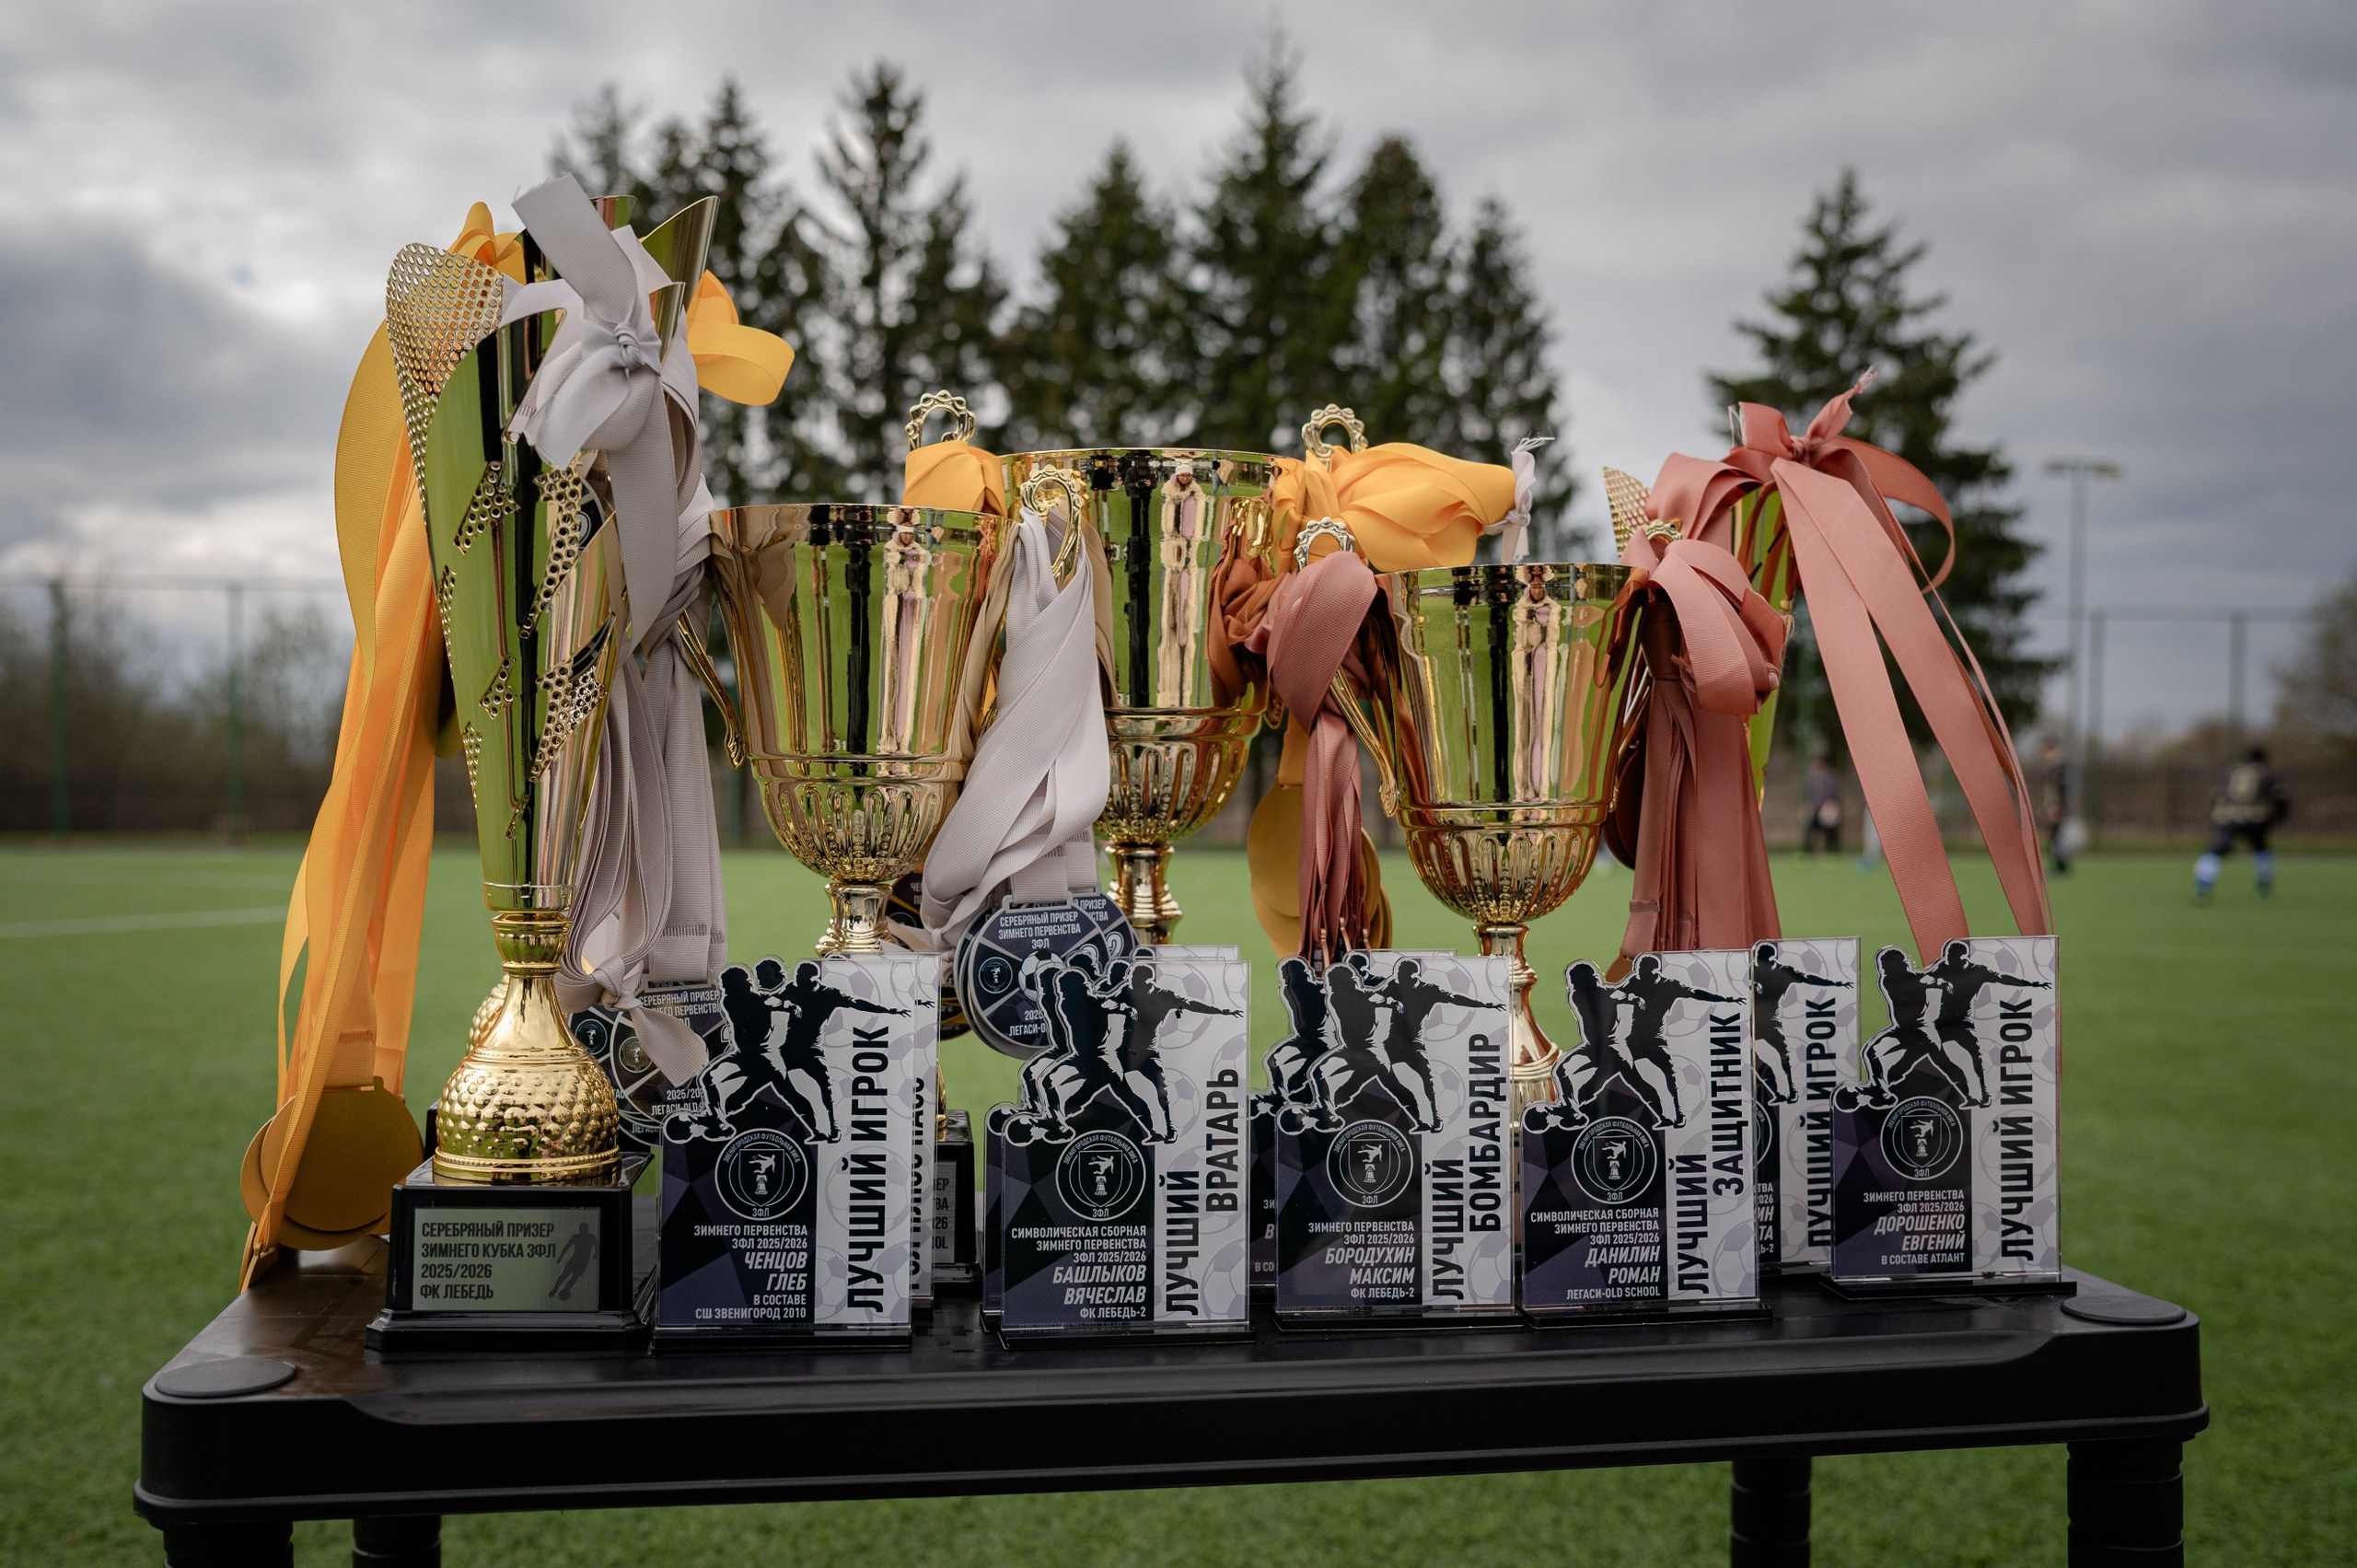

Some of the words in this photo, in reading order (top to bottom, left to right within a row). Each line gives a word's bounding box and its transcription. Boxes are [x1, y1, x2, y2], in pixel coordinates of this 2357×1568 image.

[1000, 912, 1050, 927] СЕРЕБРЯНЫЙ
[1050, 912, 1078, 923] ПРИЗЕР
[998, 926, 1033, 940] ЗИМНЕГО
[1035, 923, 1081, 937] ПЕРВЕНСТВА
[1031, 938, 1050, 949] ЗФЛ
[675, 1003, 720, 1016] ПЕРВЕНСТВ
[1805, 997, 1837, 1100] ИГРОК
[2000, 998, 2033, 1105] ИГРОК
[851, 1027, 888, 1141] ИГРОК
[1710, 1013, 1748, 1196] ЗАЩИТНИК
[1206, 1068, 1238, 1212] ВРАТАРЬ
[1469, 1033, 1506, 1232] БОМБАРДИР
[1800, 1110, 1831, 1248] ЛУЧШИЙ
[1914, 1168, 1930, 1178] ЗФЛ
[1607, 1191, 1623, 1201] ЗФЛ
[1864, 1191, 1905, 1202] ЗИМНЕГО
[1907, 1190, 1964, 1201] ПЕРВЕНСТВА
[1992, 1116, 2033, 1260] ЛУЧШИЙ
[1362, 1195, 1378, 1204] ЗФЛ
[752, 1208, 770, 1217] ЗФЛ
[1092, 1209, 1109, 1218] ЗФЛ
[1530, 1210, 1612, 1222] СИМВОЛИЧЕСКАЯ
[1615, 1208, 1659, 1220] СБОРНАЯ
[1898, 1203, 1917, 1214] ЗФЛ
[1920, 1202, 1964, 1213] 2025/2026
[422, 1221, 504, 1237] СЕРЕБРЯНЫЙ
[506, 1223, 554, 1237] ПРИЗЕР
[694, 1225, 740, 1236] ЗИМНЕГО
[743, 1225, 807, 1236] ПЕРВЕНСТВА
[1011, 1227, 1098, 1238] СИМВОЛИЧЕСКАЯ
[1100, 1225, 1146, 1237] СБОРНАЯ
[1308, 1223, 1352, 1233] ЗИМНЕГО
[1353, 1221, 1414, 1232] ПЕРВЕНСТВА
[1425, 1159, 1464, 1300] ЛУЧШИЙ
[1554, 1223, 1597, 1234] ЗИМНЕГО
[1600, 1220, 1659, 1232] ПЕРВЕНСТВА
[1668, 1154, 1709, 1294] ЛУЧШИЙ
[1874, 1214, 1966, 1236] ДОРОШЕНКО
[842, 1154, 887, 1313] ЛУЧШИЙ
[1343, 1235, 1364, 1245] ЗФЛ
[1367, 1234, 1414, 1244] 2025/2026
[1590, 1235, 1610, 1245] ЗФЛ
[1613, 1233, 1659, 1244] 2025/2026
[1902, 1230, 1966, 1251] ЕВГЕНИЙ
[421, 1243, 480, 1259] ЗИМНЕГО
[482, 1243, 524, 1258] КУБКА
[527, 1243, 556, 1258] ЗФЛ
[732, 1238, 754, 1249] ЗФЛ
[757, 1238, 807, 1249] 2025/2026
[1037, 1240, 1082, 1251] ЗИМНЕГО
[1085, 1238, 1146, 1249] ПЕРВЕНСТВА
[1159, 1170, 1200, 1316] ЛУЧШИЙ
[745, 1252, 807, 1272] ЧЕНЦОВ
[1073, 1252, 1095, 1263] ЗФЛ
[1097, 1251, 1146, 1262] 2025/2026
[1325, 1247, 1415, 1266] БОРОДУХИН
[1585, 1246, 1660, 1267] ДАНИЛИН
[1881, 1255, 1887, 1265] В
[1889, 1253, 1929, 1264] СОСТАВЕ
[1930, 1252, 1965, 1263] АТЛАНТ
[421, 1263, 493, 1279] 2025/2026
[1052, 1265, 1146, 1283] БАШЛЫКОВ
[1349, 1267, 1415, 1284] МАКСИМ
[1608, 1267, 1660, 1284] РОМАН
[766, 1272, 807, 1291] ГЛЕБ
[420, 1283, 439, 1299] ФК
[443, 1284, 494, 1300] ЛЕБЕДЬ
[1064, 1286, 1146, 1304] ВЯЧЕСЛАВ
[1351, 1288, 1366, 1298] ФК
[1368, 1287, 1414, 1299] ЛЕБЕДЬ-2
[1625, 1286, 1660, 1297] SCHOOL
[753, 1295, 760, 1305] В
[762, 1295, 807, 1305] СОСТАВЕ
[695, 1308, 713, 1319] СШ
[714, 1307, 780, 1320] ЗВЕНИГОРОД
[783, 1307, 807, 1318] 2010
[1080, 1308, 1096, 1318] ФК
[1097, 1307, 1146, 1318] ЛЕБЕДЬ-2
